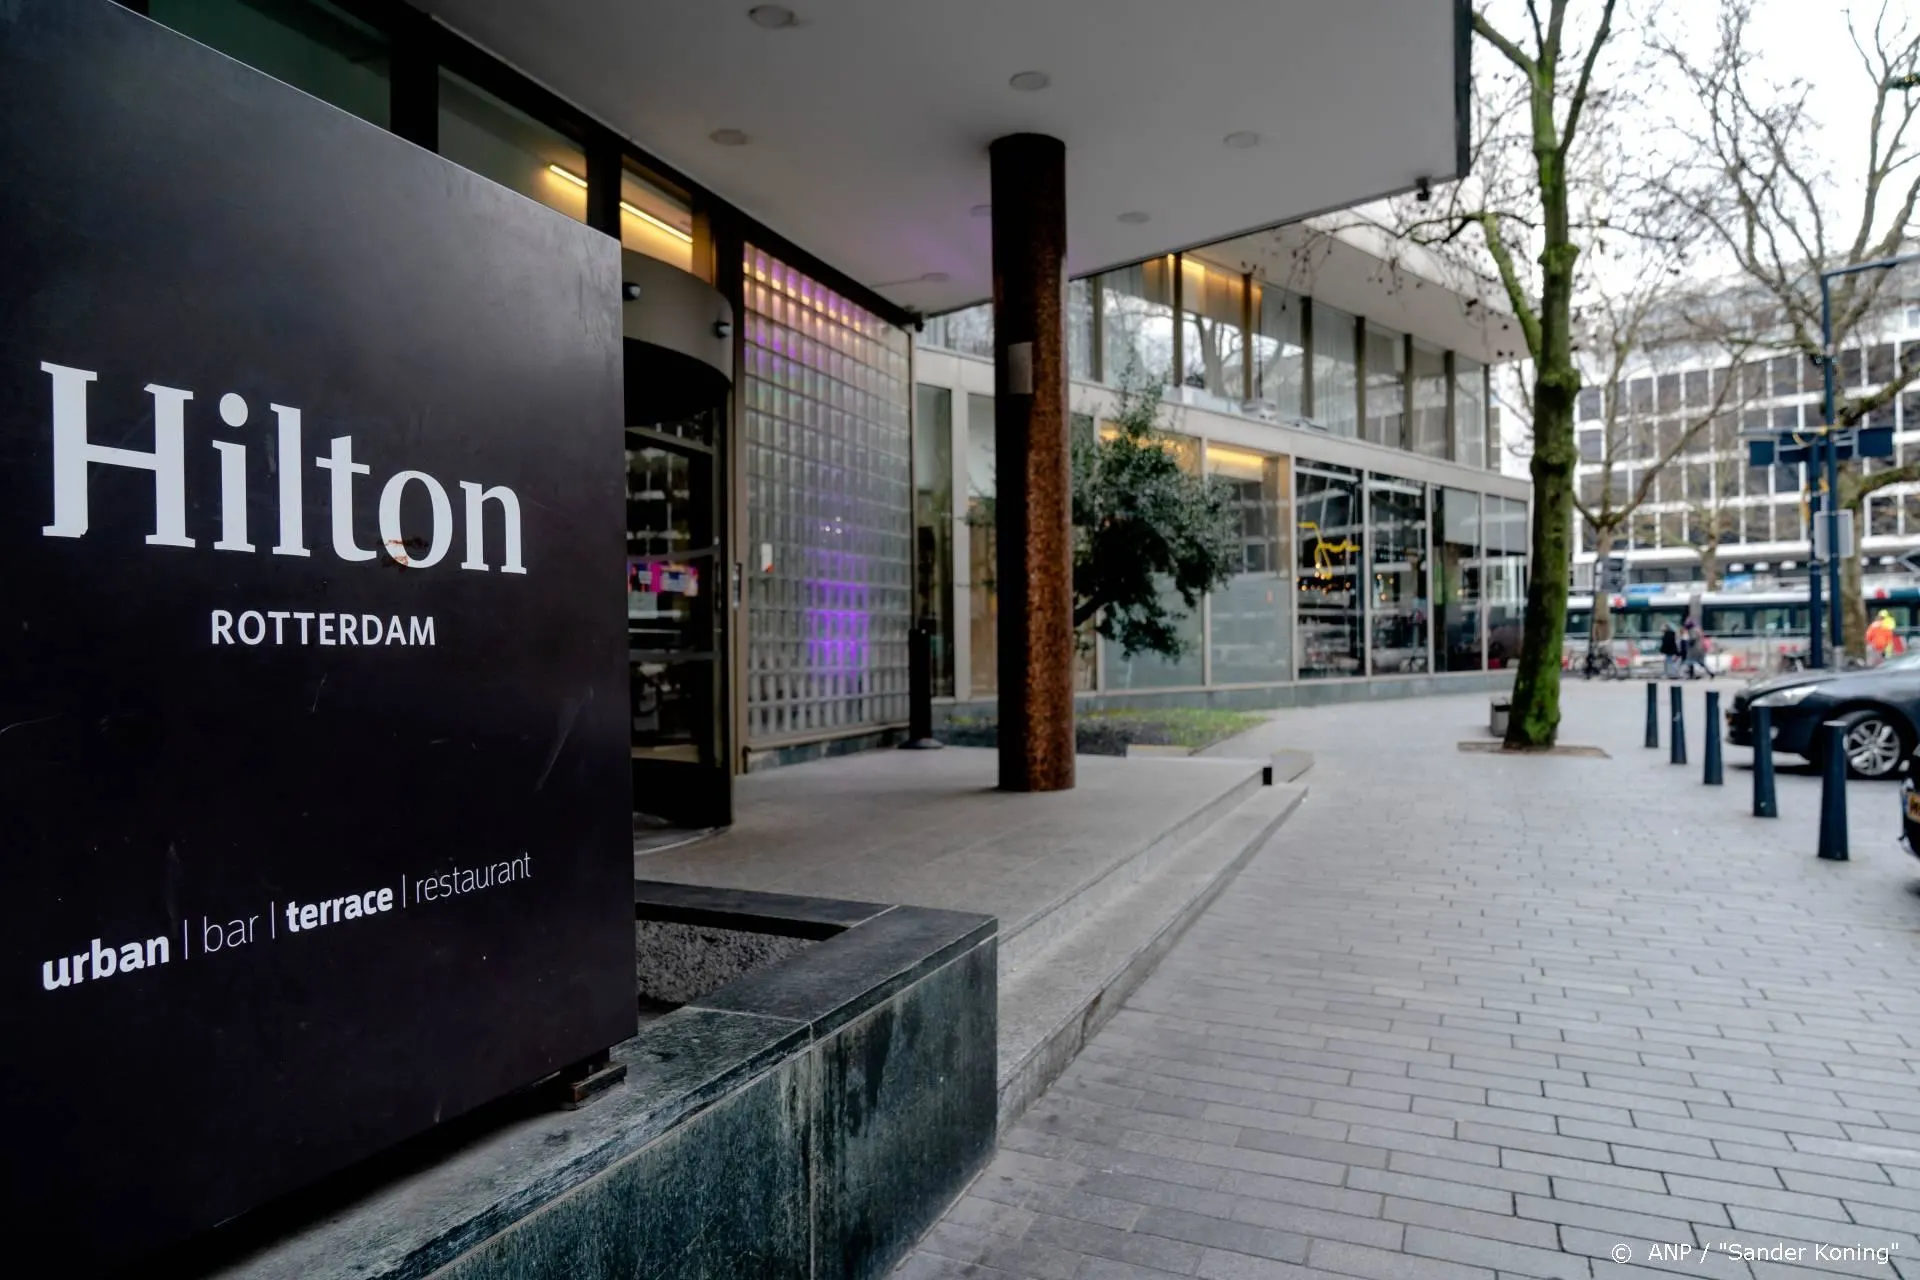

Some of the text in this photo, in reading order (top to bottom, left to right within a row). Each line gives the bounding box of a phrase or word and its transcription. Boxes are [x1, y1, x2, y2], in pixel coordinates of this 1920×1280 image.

[41, 361, 527, 575] Hilton
[211, 609, 436, 646] ROTTERDAM
[42, 851, 532, 991] urban bar terrace restaurant
